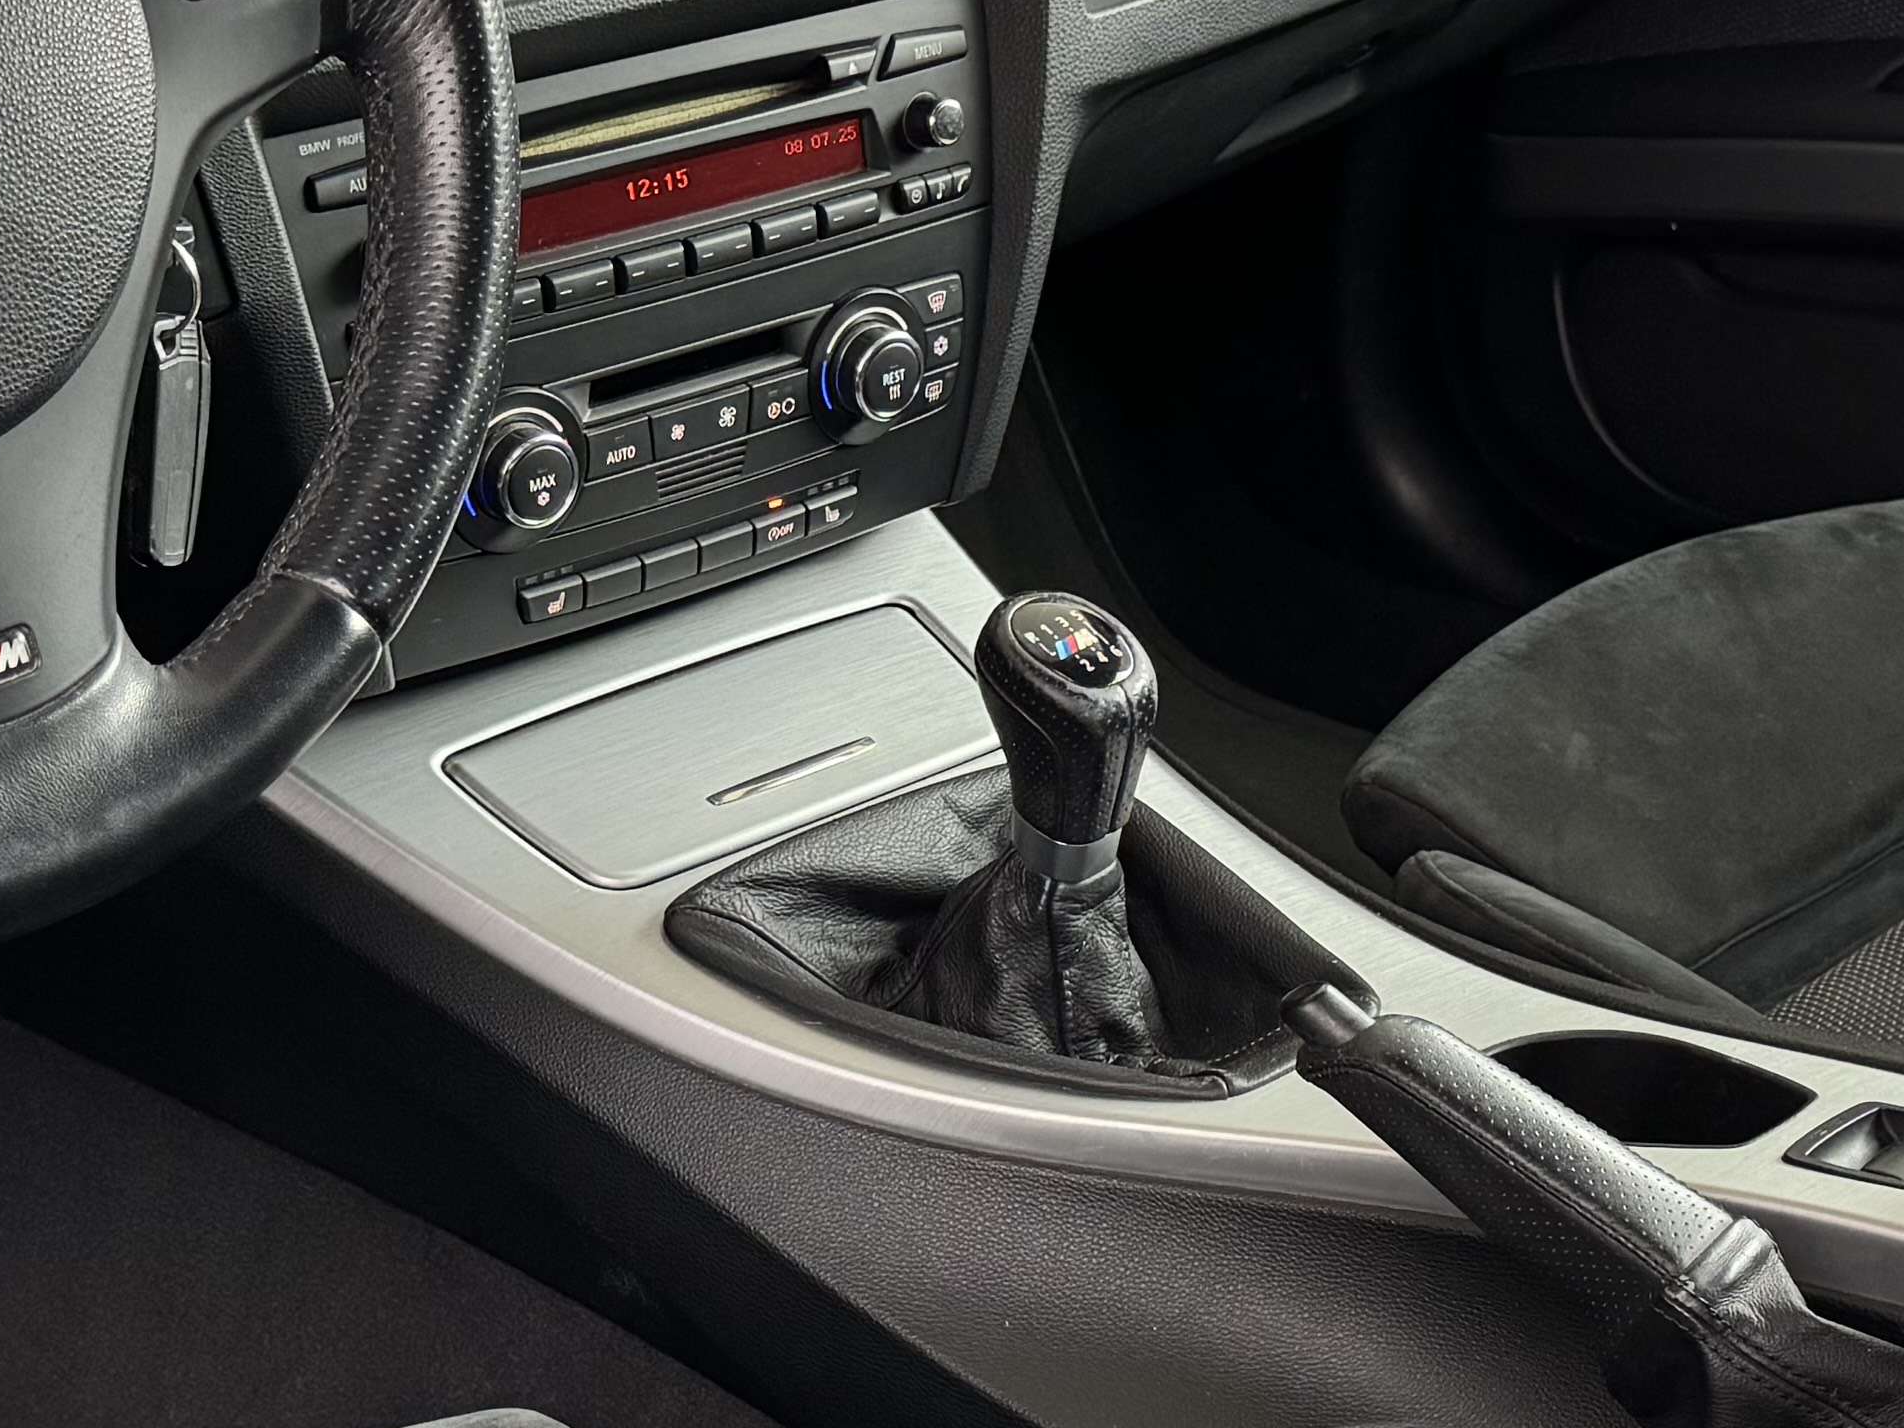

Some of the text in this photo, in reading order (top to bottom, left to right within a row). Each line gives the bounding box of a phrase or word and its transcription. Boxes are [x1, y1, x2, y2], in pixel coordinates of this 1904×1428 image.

[913, 40, 944, 61] MENU
[298, 138, 331, 157] BMW
[349, 177, 367, 194] AU
[625, 167, 690, 202] 12:15
[882, 368, 906, 387] REST
[606, 444, 637, 466] AUTO
[528, 473, 557, 493] MAX
